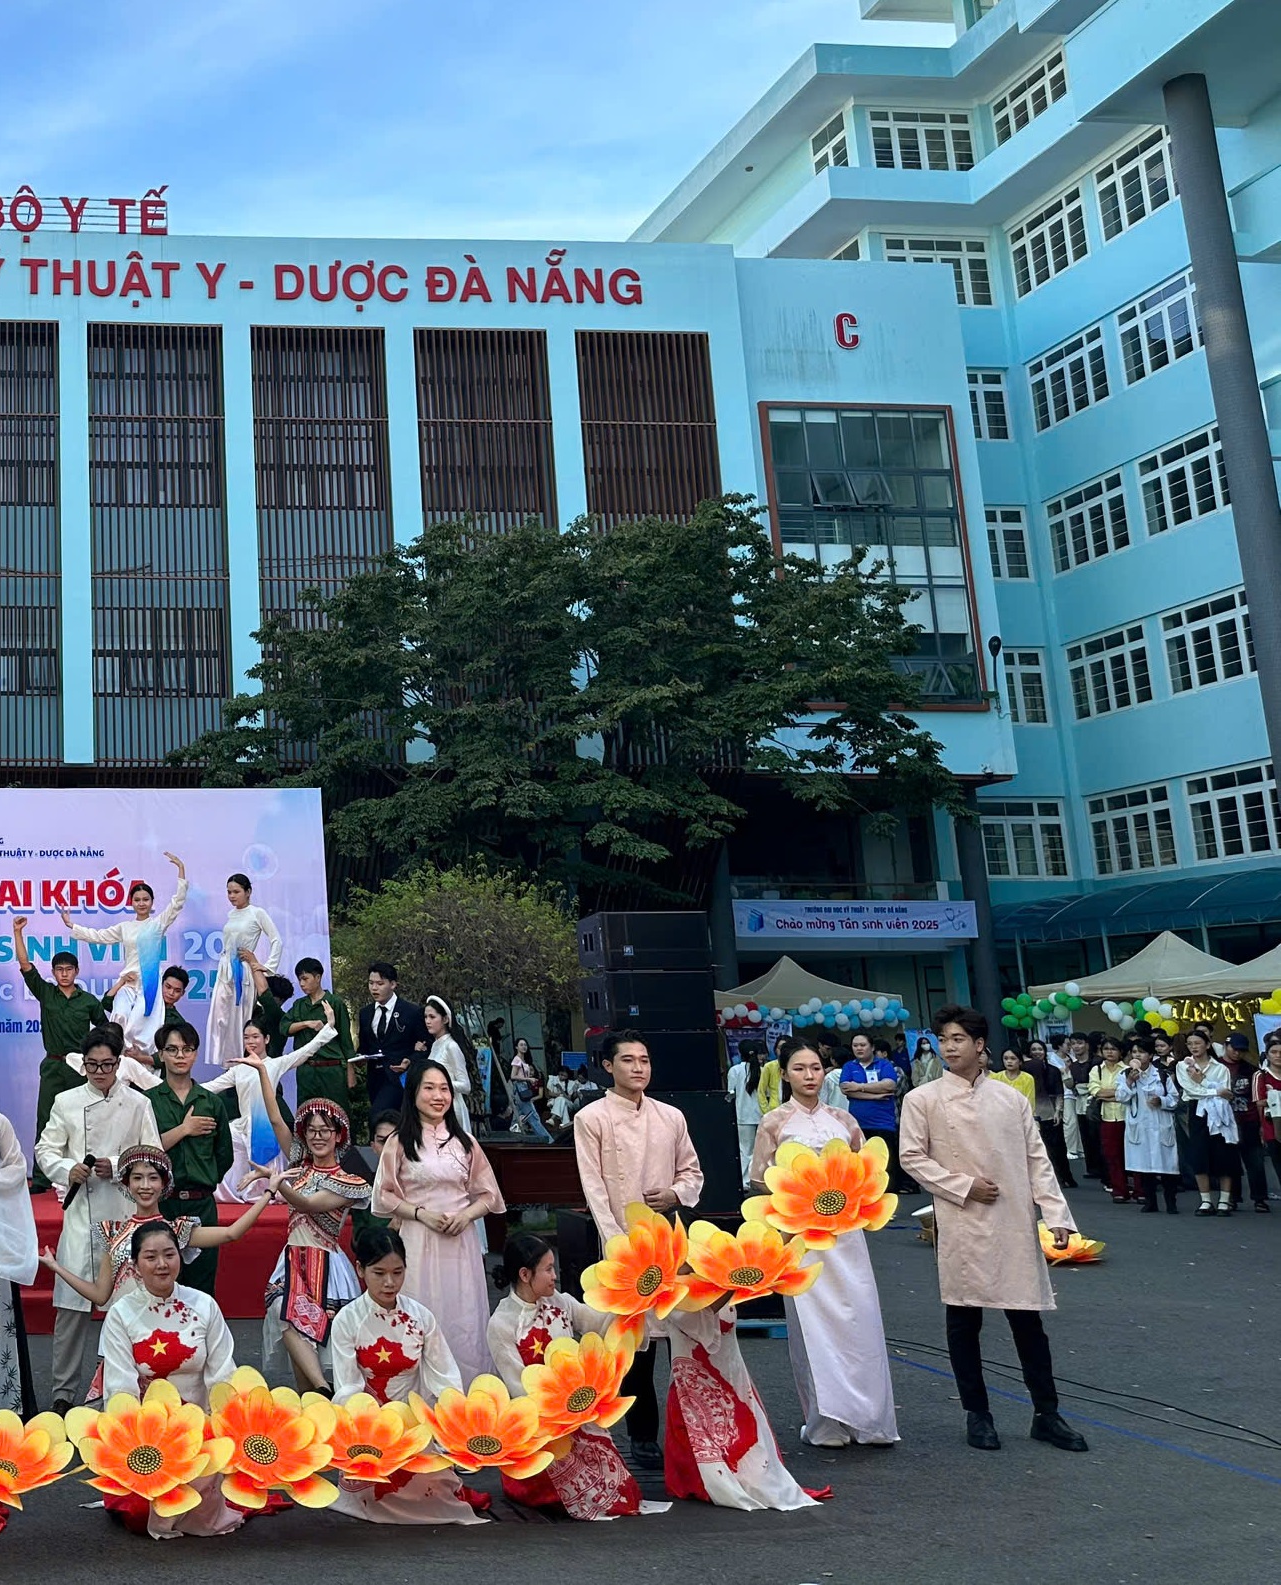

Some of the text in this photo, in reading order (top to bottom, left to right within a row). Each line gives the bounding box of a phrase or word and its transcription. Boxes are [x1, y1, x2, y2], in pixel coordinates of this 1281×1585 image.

[59, 196, 89, 233] Y
[108, 185, 169, 235] TẾ
[20, 251, 180, 307] THUẬT
[195, 262, 227, 298] Y
[274, 260, 408, 312] DƯỢC
[425, 255, 492, 304] ĐÀ
[507, 249, 643, 305] NẴNG
[834, 312, 859, 350] C
[0, 848, 26, 860] THUẬT
[39, 849, 64, 860] DƯỢC
[79, 846, 105, 858] NẴNG
[776, 916, 939, 931] Chào mừng Tân sinh viên 2025
